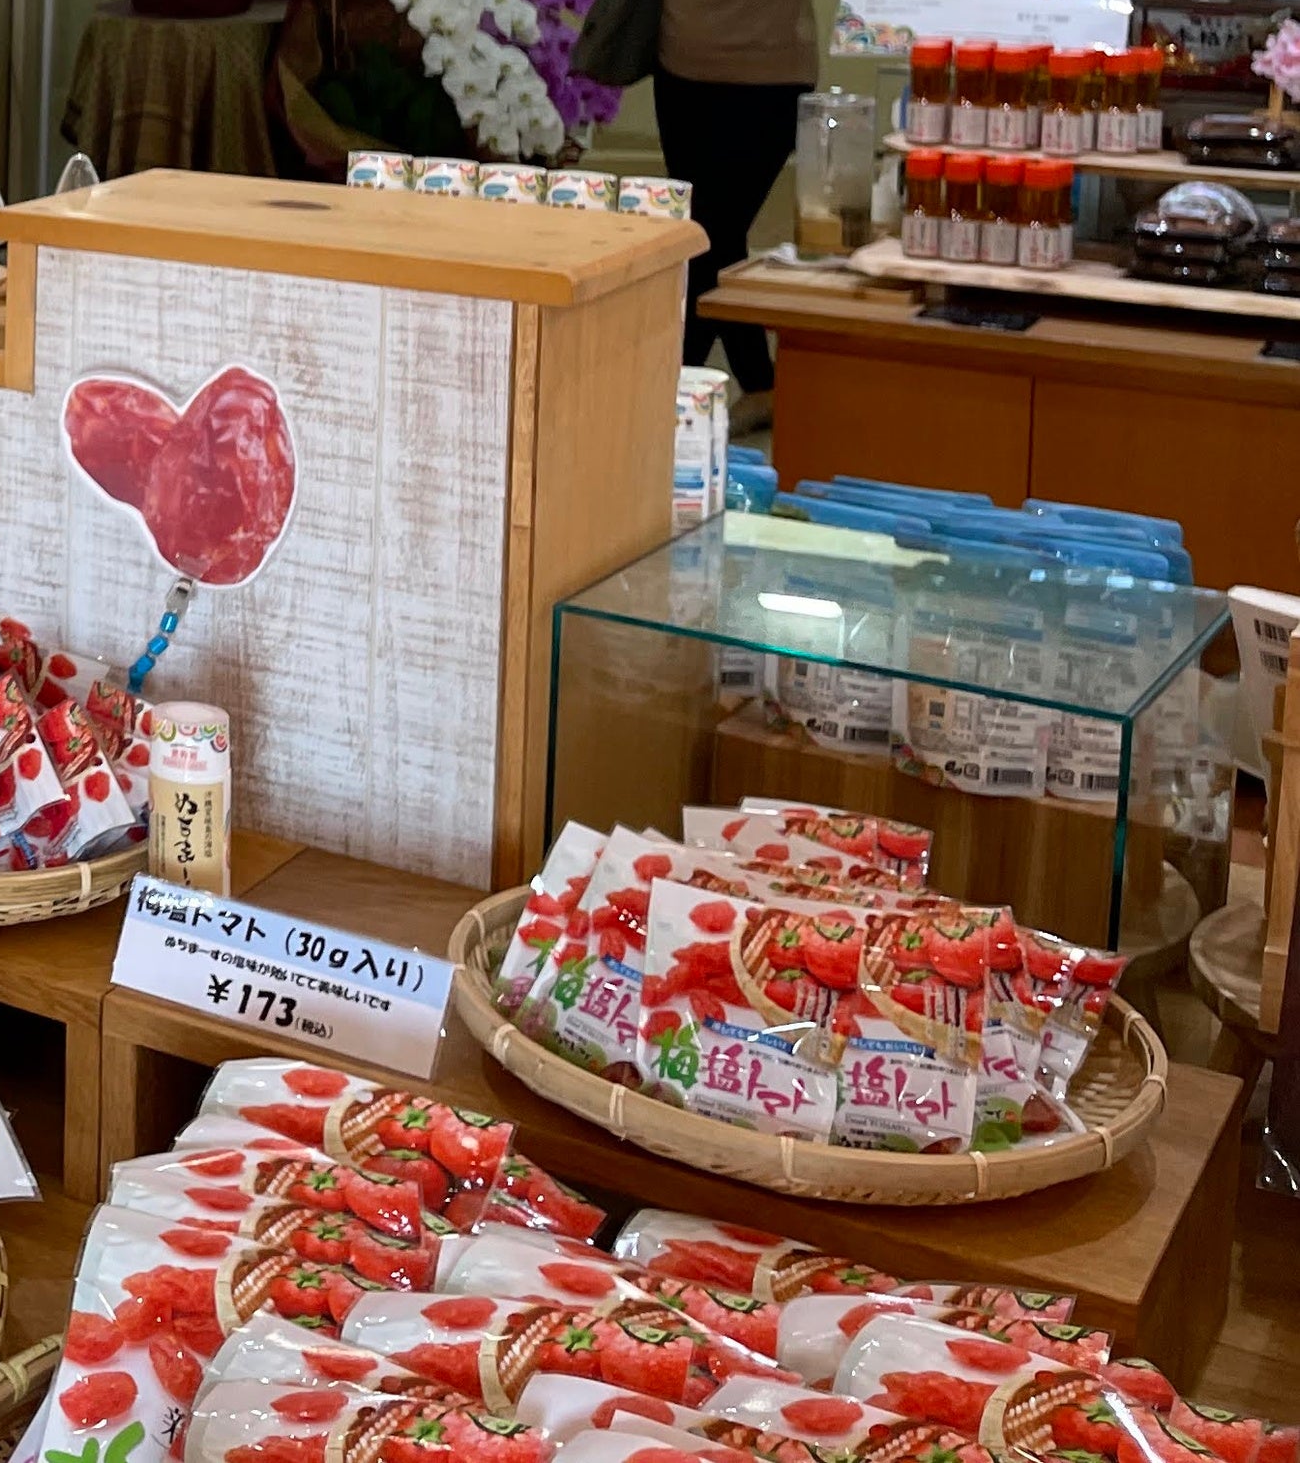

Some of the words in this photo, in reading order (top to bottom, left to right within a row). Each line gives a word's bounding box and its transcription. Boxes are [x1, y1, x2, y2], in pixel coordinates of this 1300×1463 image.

[173, 791, 201, 886] ぬちまー
[206, 973, 298, 1028] ¥173
